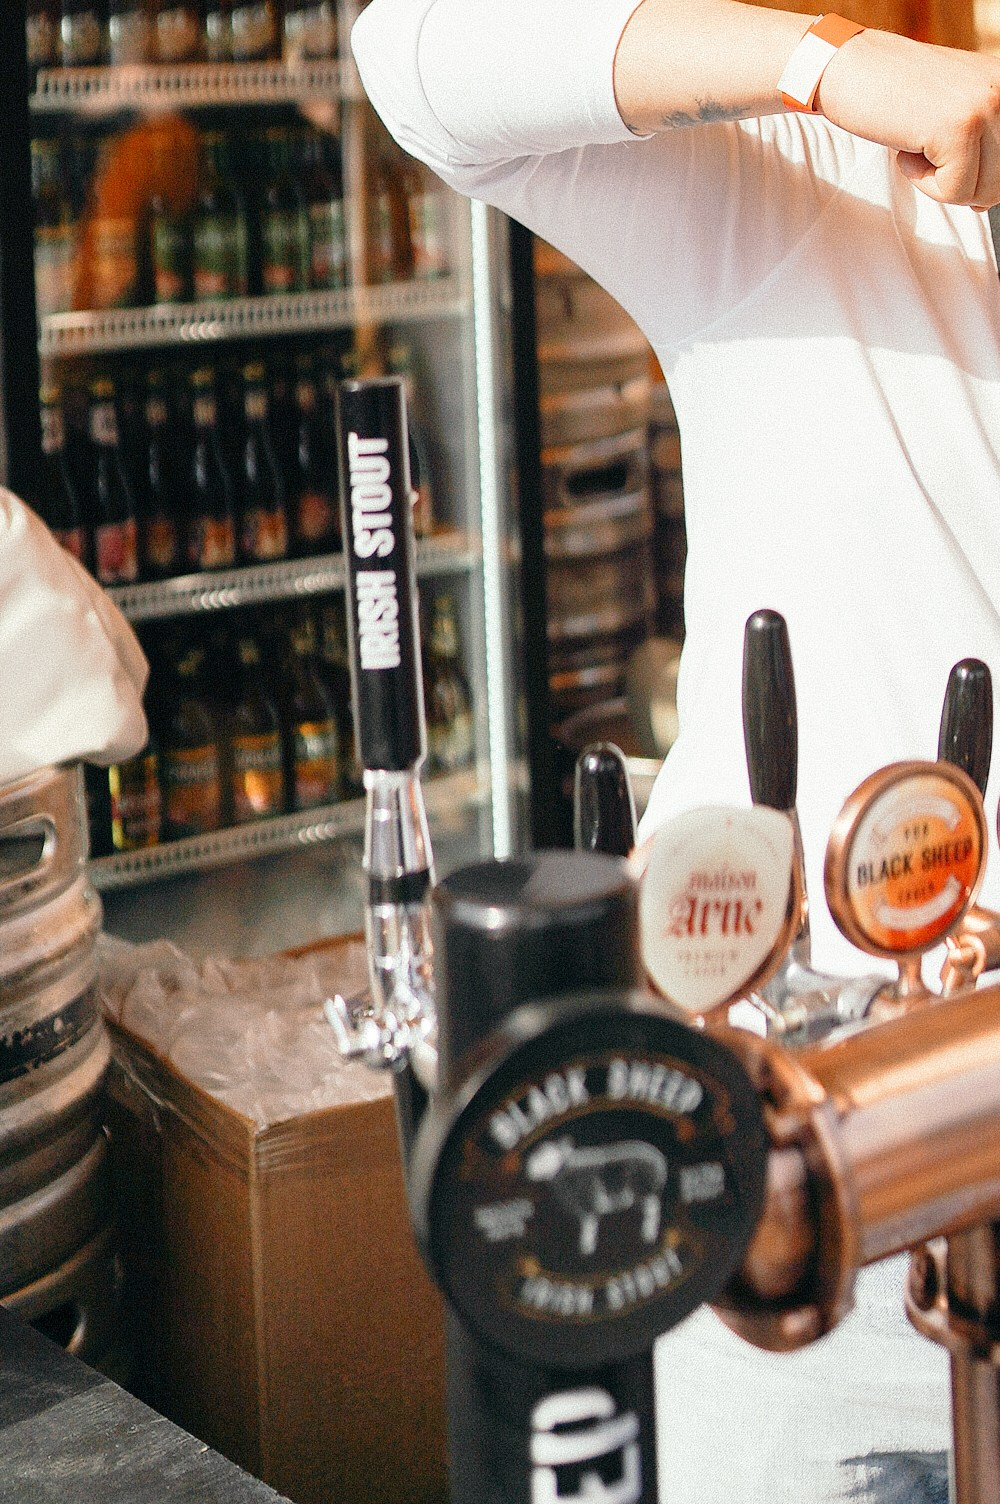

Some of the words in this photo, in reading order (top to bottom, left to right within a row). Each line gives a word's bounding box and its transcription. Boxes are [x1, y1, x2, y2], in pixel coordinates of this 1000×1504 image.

[347, 431, 396, 560] STOUT
[355, 569, 402, 671] IRISH
[857, 853, 913, 887] BLACK
[920, 835, 974, 870] SHEEP
